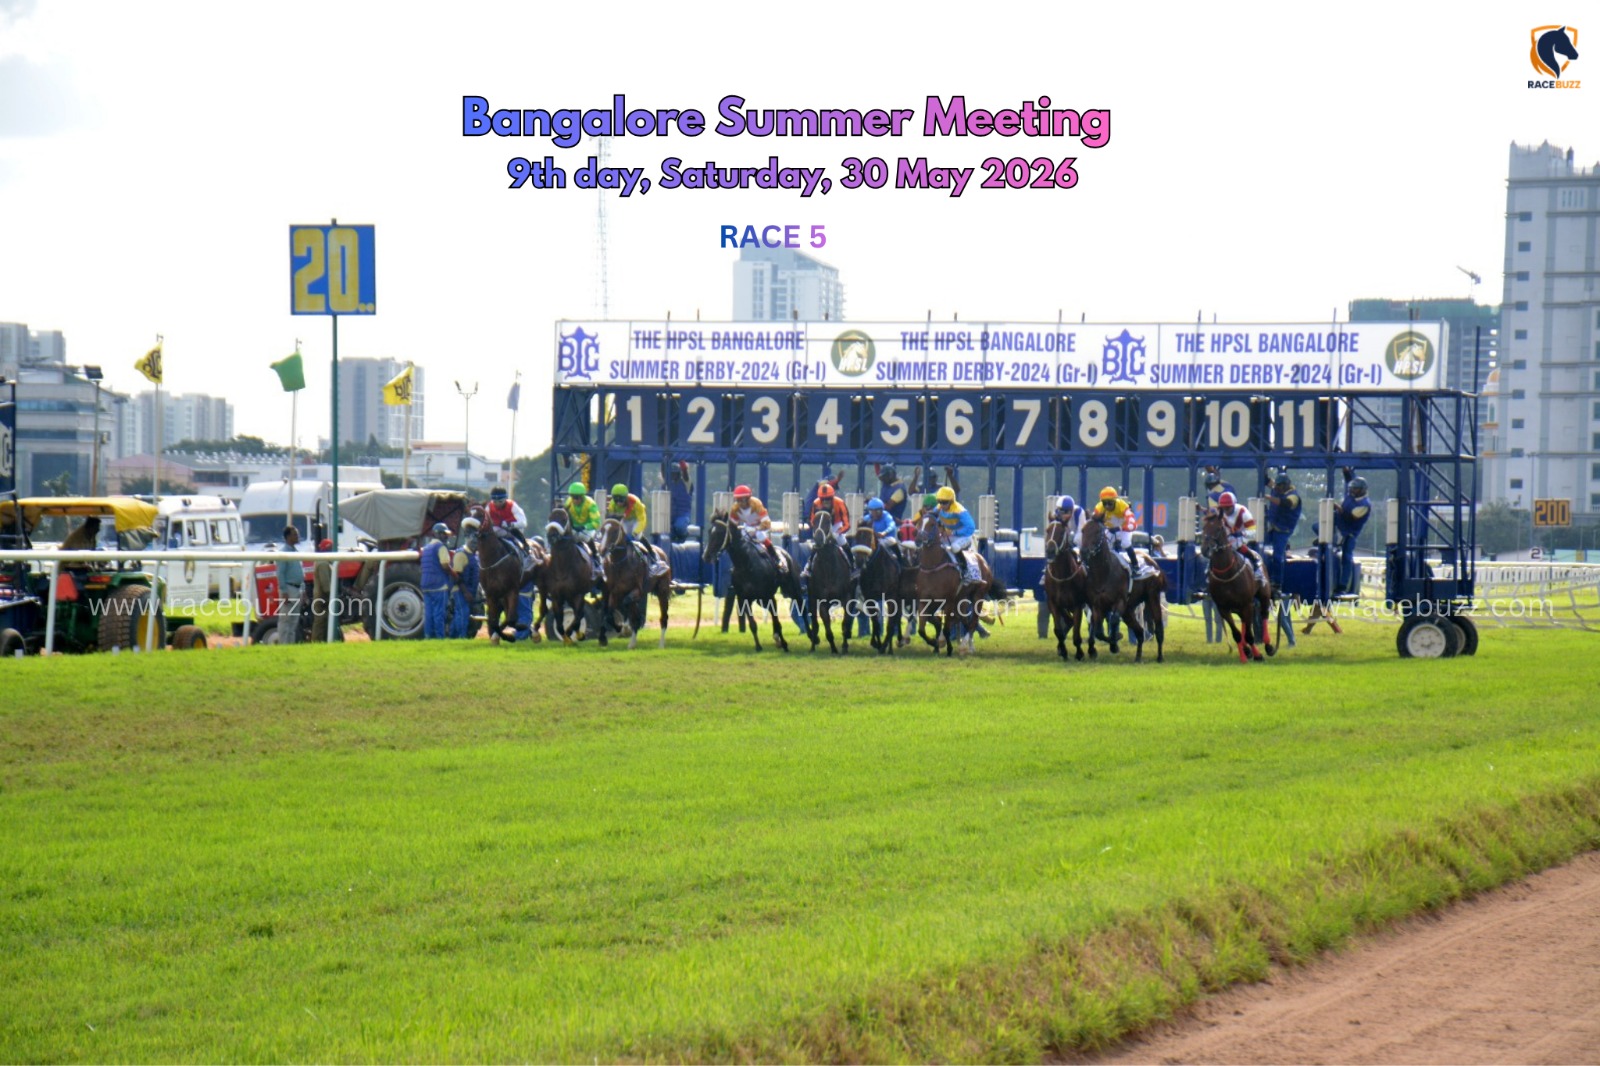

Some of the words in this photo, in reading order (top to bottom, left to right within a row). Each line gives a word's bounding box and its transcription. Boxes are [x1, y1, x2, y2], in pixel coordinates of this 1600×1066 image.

[633, 331, 661, 350] THE
[667, 331, 706, 350] HPSL
[712, 331, 804, 351] BANGALORE
[901, 331, 928, 351] THE
[934, 331, 974, 351] HPSL
[981, 332, 1076, 353] BANGALORE
[1175, 333, 1204, 353] THE
[1210, 333, 1252, 353] HPSL
[1258, 333, 1360, 353] BANGALORE
[609, 360, 680, 381] SUMMER
[685, 361, 780, 382] DERBY-2024
[876, 362, 947, 382] SUMMER
[953, 362, 1050, 383] DERBY-2024
[1150, 364, 1223, 385] SUMMER
[1229, 364, 1333, 385] DERBY-2024
[626, 395, 643, 442] 1
[686, 397, 716, 443] 2
[750, 397, 781, 444] 3
[814, 398, 844, 445] 4
[880, 399, 909, 446] 5
[944, 399, 974, 446] 6
[1012, 400, 1042, 446] 7
[1078, 400, 1109, 447] 8
[1146, 400, 1176, 447] 9
[1205, 401, 1250, 448] 10
[1278, 402, 1316, 448] 11
[1535, 500, 1569, 525] 200
[1530, 547, 1541, 560] 2
